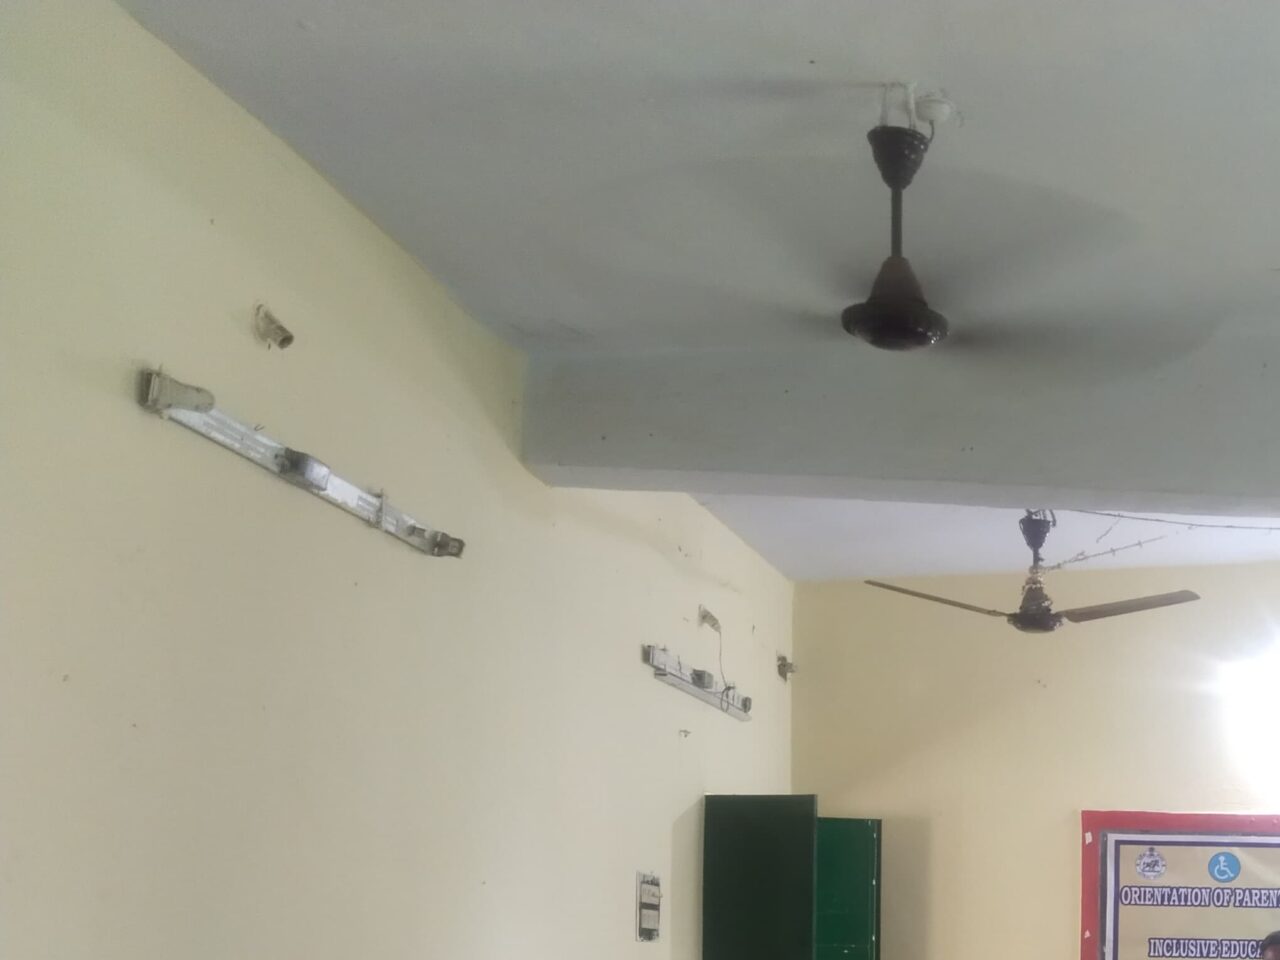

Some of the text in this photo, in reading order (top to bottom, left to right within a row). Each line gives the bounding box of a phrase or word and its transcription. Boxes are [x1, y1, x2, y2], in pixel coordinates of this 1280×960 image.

[1121, 886, 1211, 906] ORIENTATION
[1213, 888, 1234, 907] OF
[1149, 938, 1220, 957] INCLUSIVE
